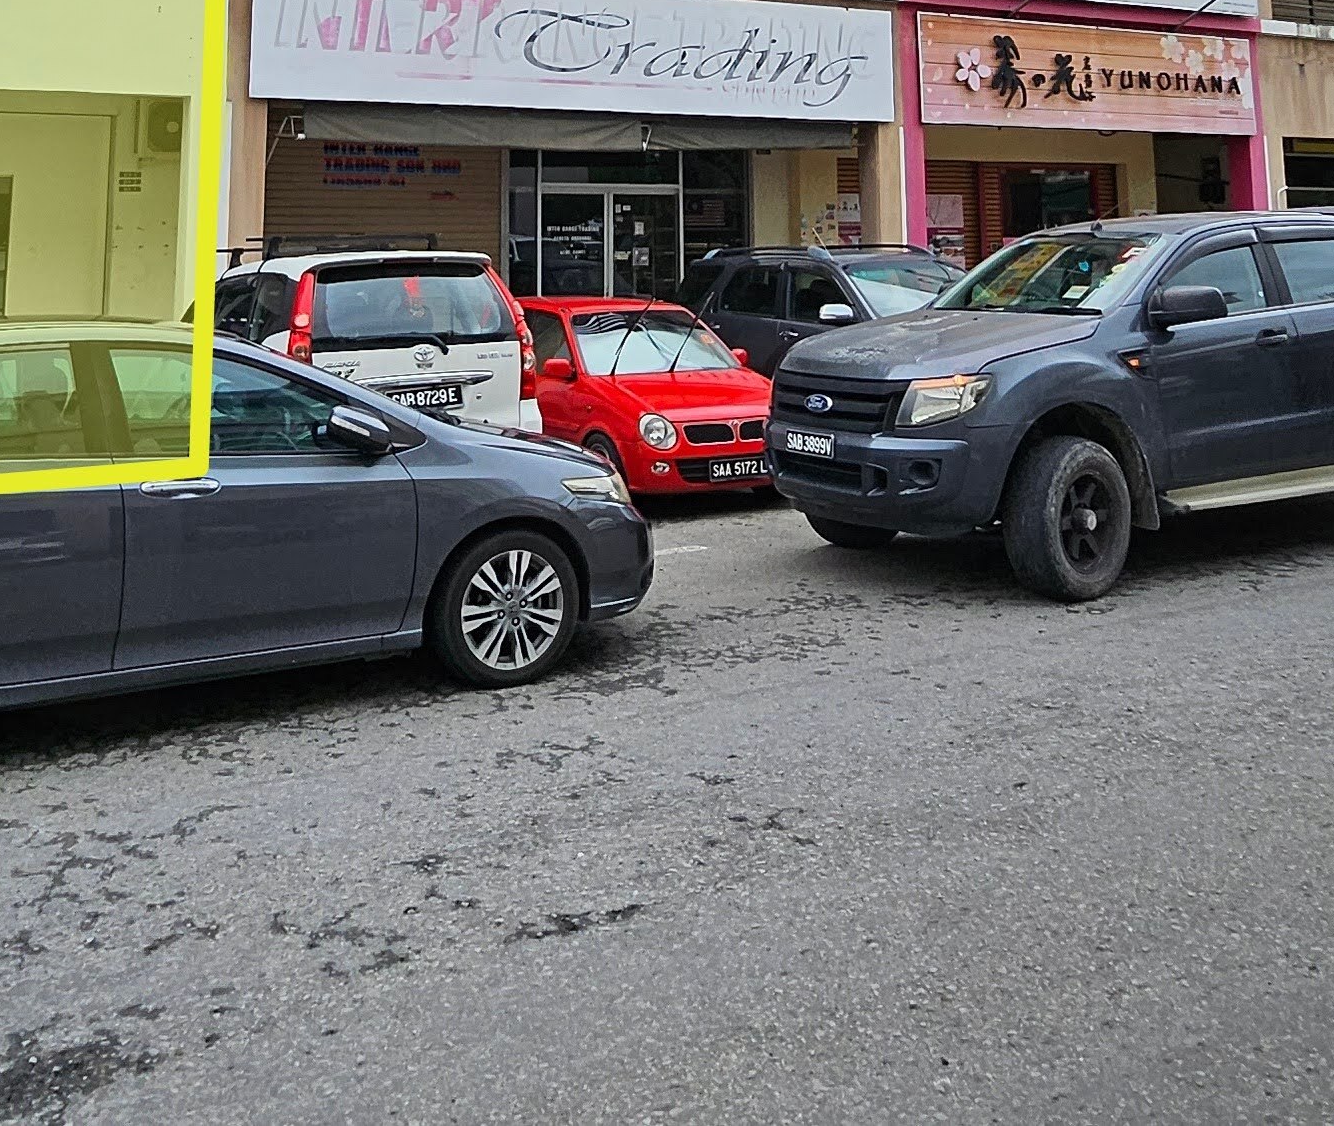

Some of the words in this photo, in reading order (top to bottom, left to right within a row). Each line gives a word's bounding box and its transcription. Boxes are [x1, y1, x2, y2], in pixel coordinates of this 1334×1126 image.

[495, 9, 869, 107] Trading
[1100, 67, 1241, 95] YUNOHANA
[417, 389, 448, 406] 8729
[712, 463, 732, 477] SAA
[734, 460, 758, 475] 5172
[760, 460, 768, 474] L
